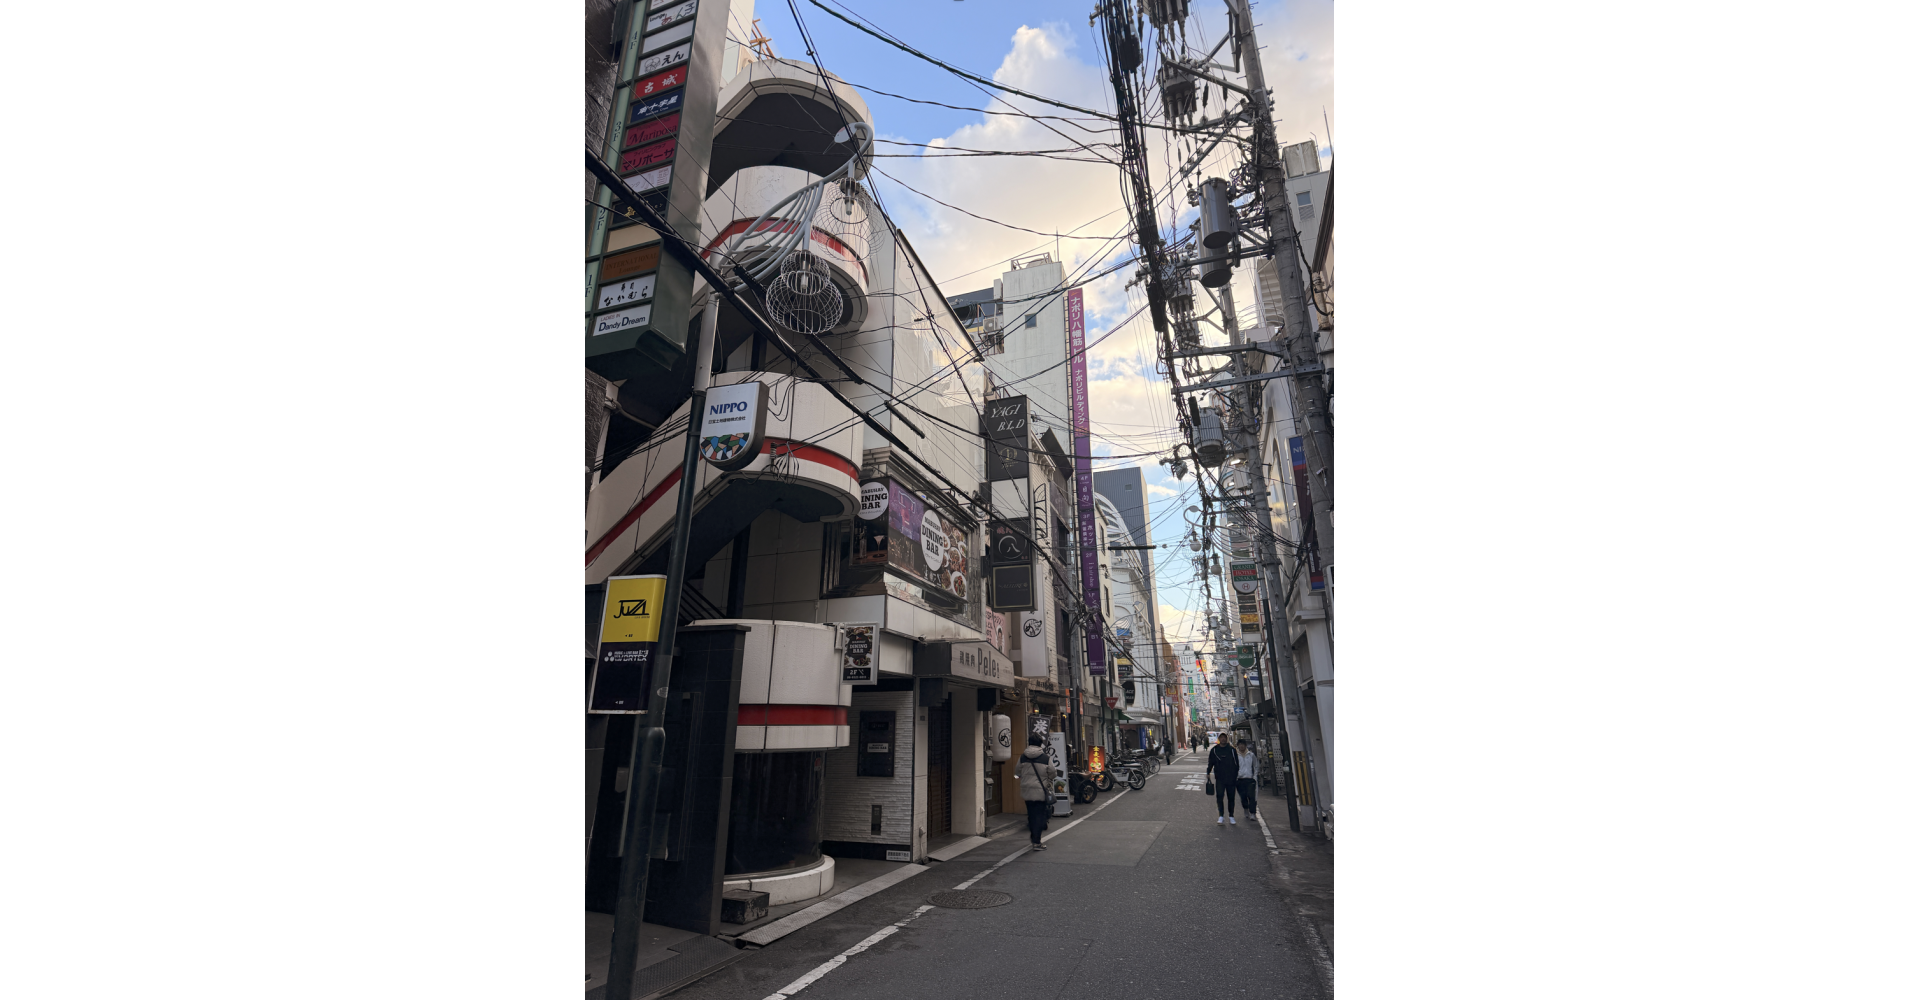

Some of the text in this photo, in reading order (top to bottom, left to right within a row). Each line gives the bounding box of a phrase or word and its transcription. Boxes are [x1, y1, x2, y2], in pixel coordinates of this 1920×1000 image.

[662, 50, 684, 66] えん
[644, 73, 678, 93] 古城
[613, 121, 622, 142] 3F
[627, 125, 677, 147] Mariposa
[596, 207, 606, 231] 2F
[606, 253, 656, 270] INTERNATIONAL
[599, 316, 645, 332] Dandy Dream
[709, 401, 748, 415] NIPPO
[991, 404, 1022, 418] YAGI
[862, 501, 881, 510] BAR
[922, 524, 944, 547] DINING
[926, 539, 940, 556] BAR
